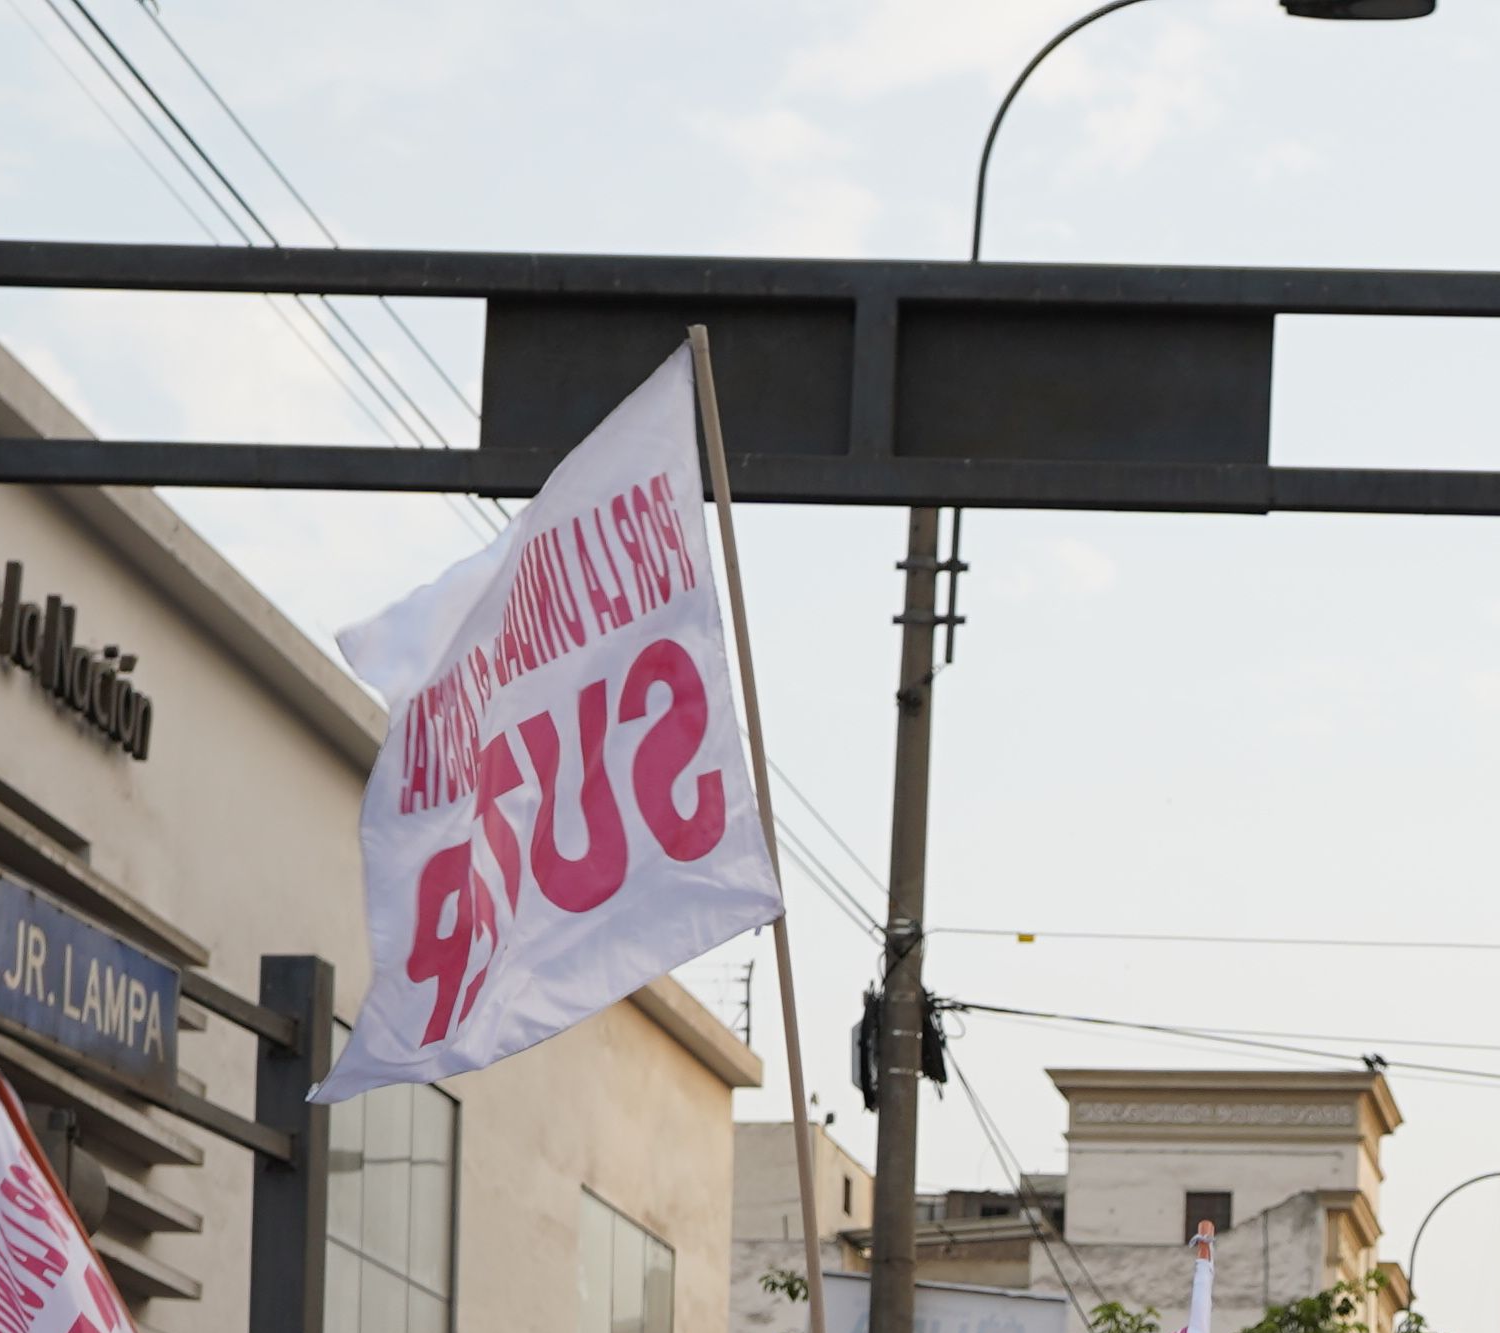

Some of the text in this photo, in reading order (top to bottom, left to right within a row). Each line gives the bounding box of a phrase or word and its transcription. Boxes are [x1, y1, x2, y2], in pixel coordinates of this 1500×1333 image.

[1, 560, 41, 674] la
[40, 594, 153, 762] Nación
[3, 919, 164, 1064] JR. LAMPA
